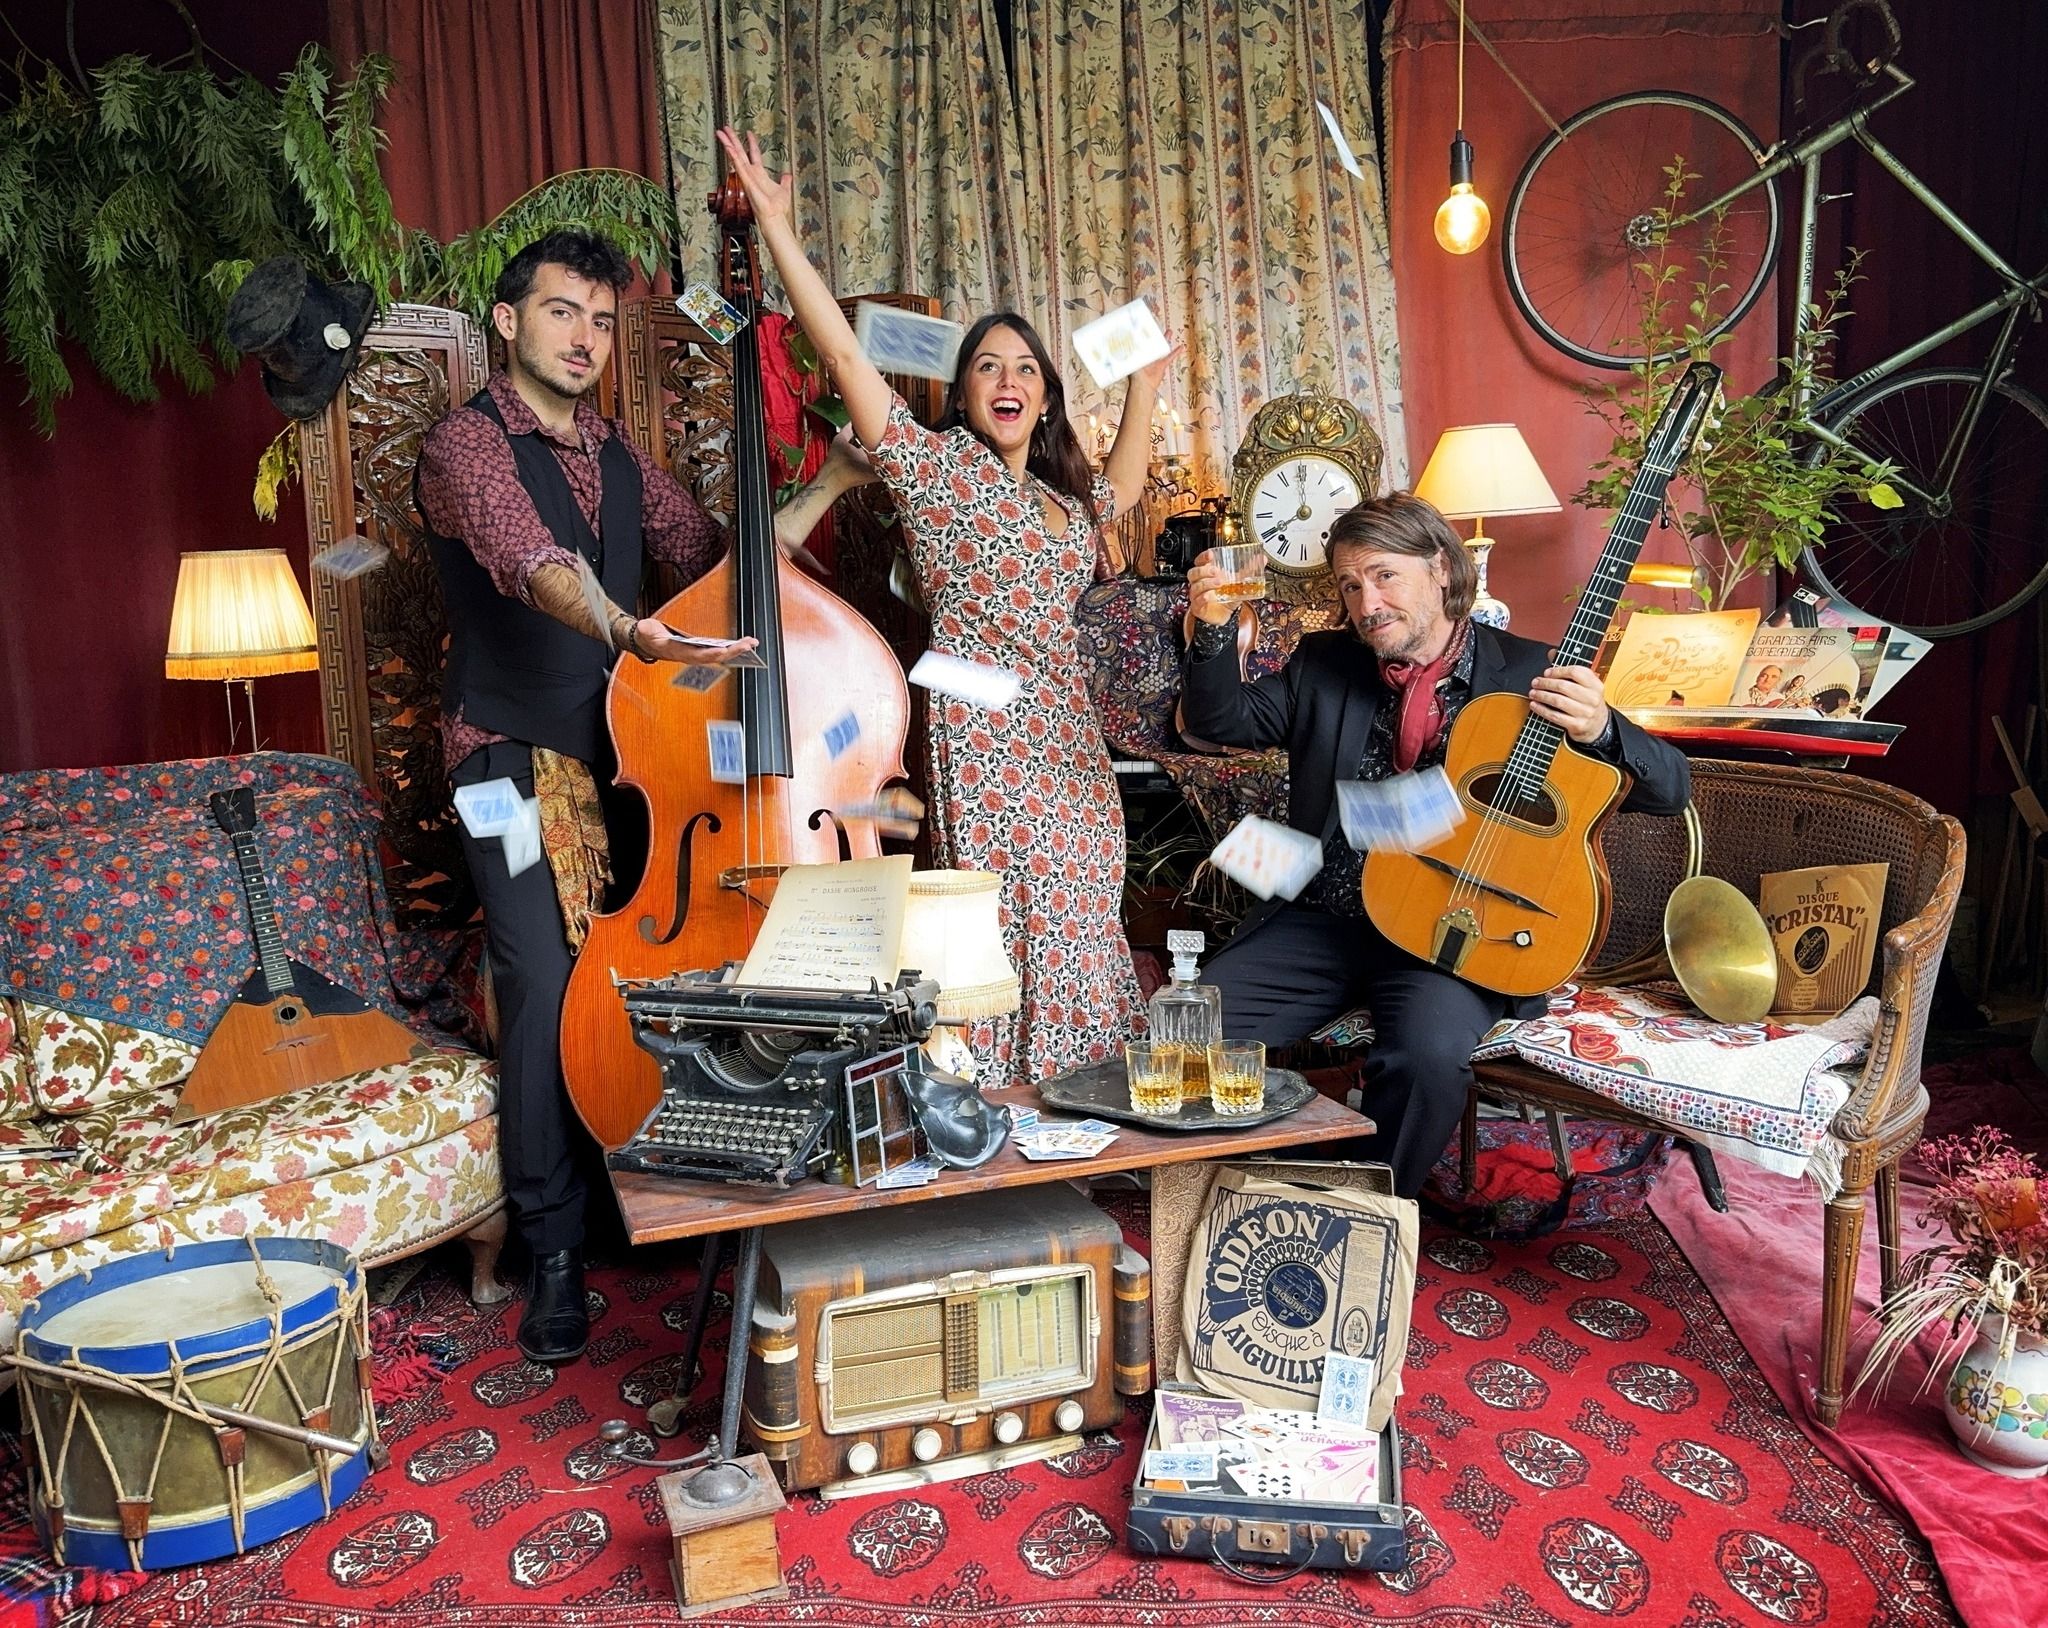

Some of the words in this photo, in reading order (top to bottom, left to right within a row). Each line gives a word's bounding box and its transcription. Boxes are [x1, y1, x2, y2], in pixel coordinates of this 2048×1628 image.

[1803, 223, 1815, 287] MOTOBECANE
[1757, 635, 1806, 646] GRANDS
[1808, 635, 1837, 646] AIRS
[1797, 892, 1840, 905] DISQUE
[1214, 1209, 1324, 1293] ODEON
[1272, 1284, 1314, 1321] Columbia
[1252, 1311, 1310, 1356] Disque
